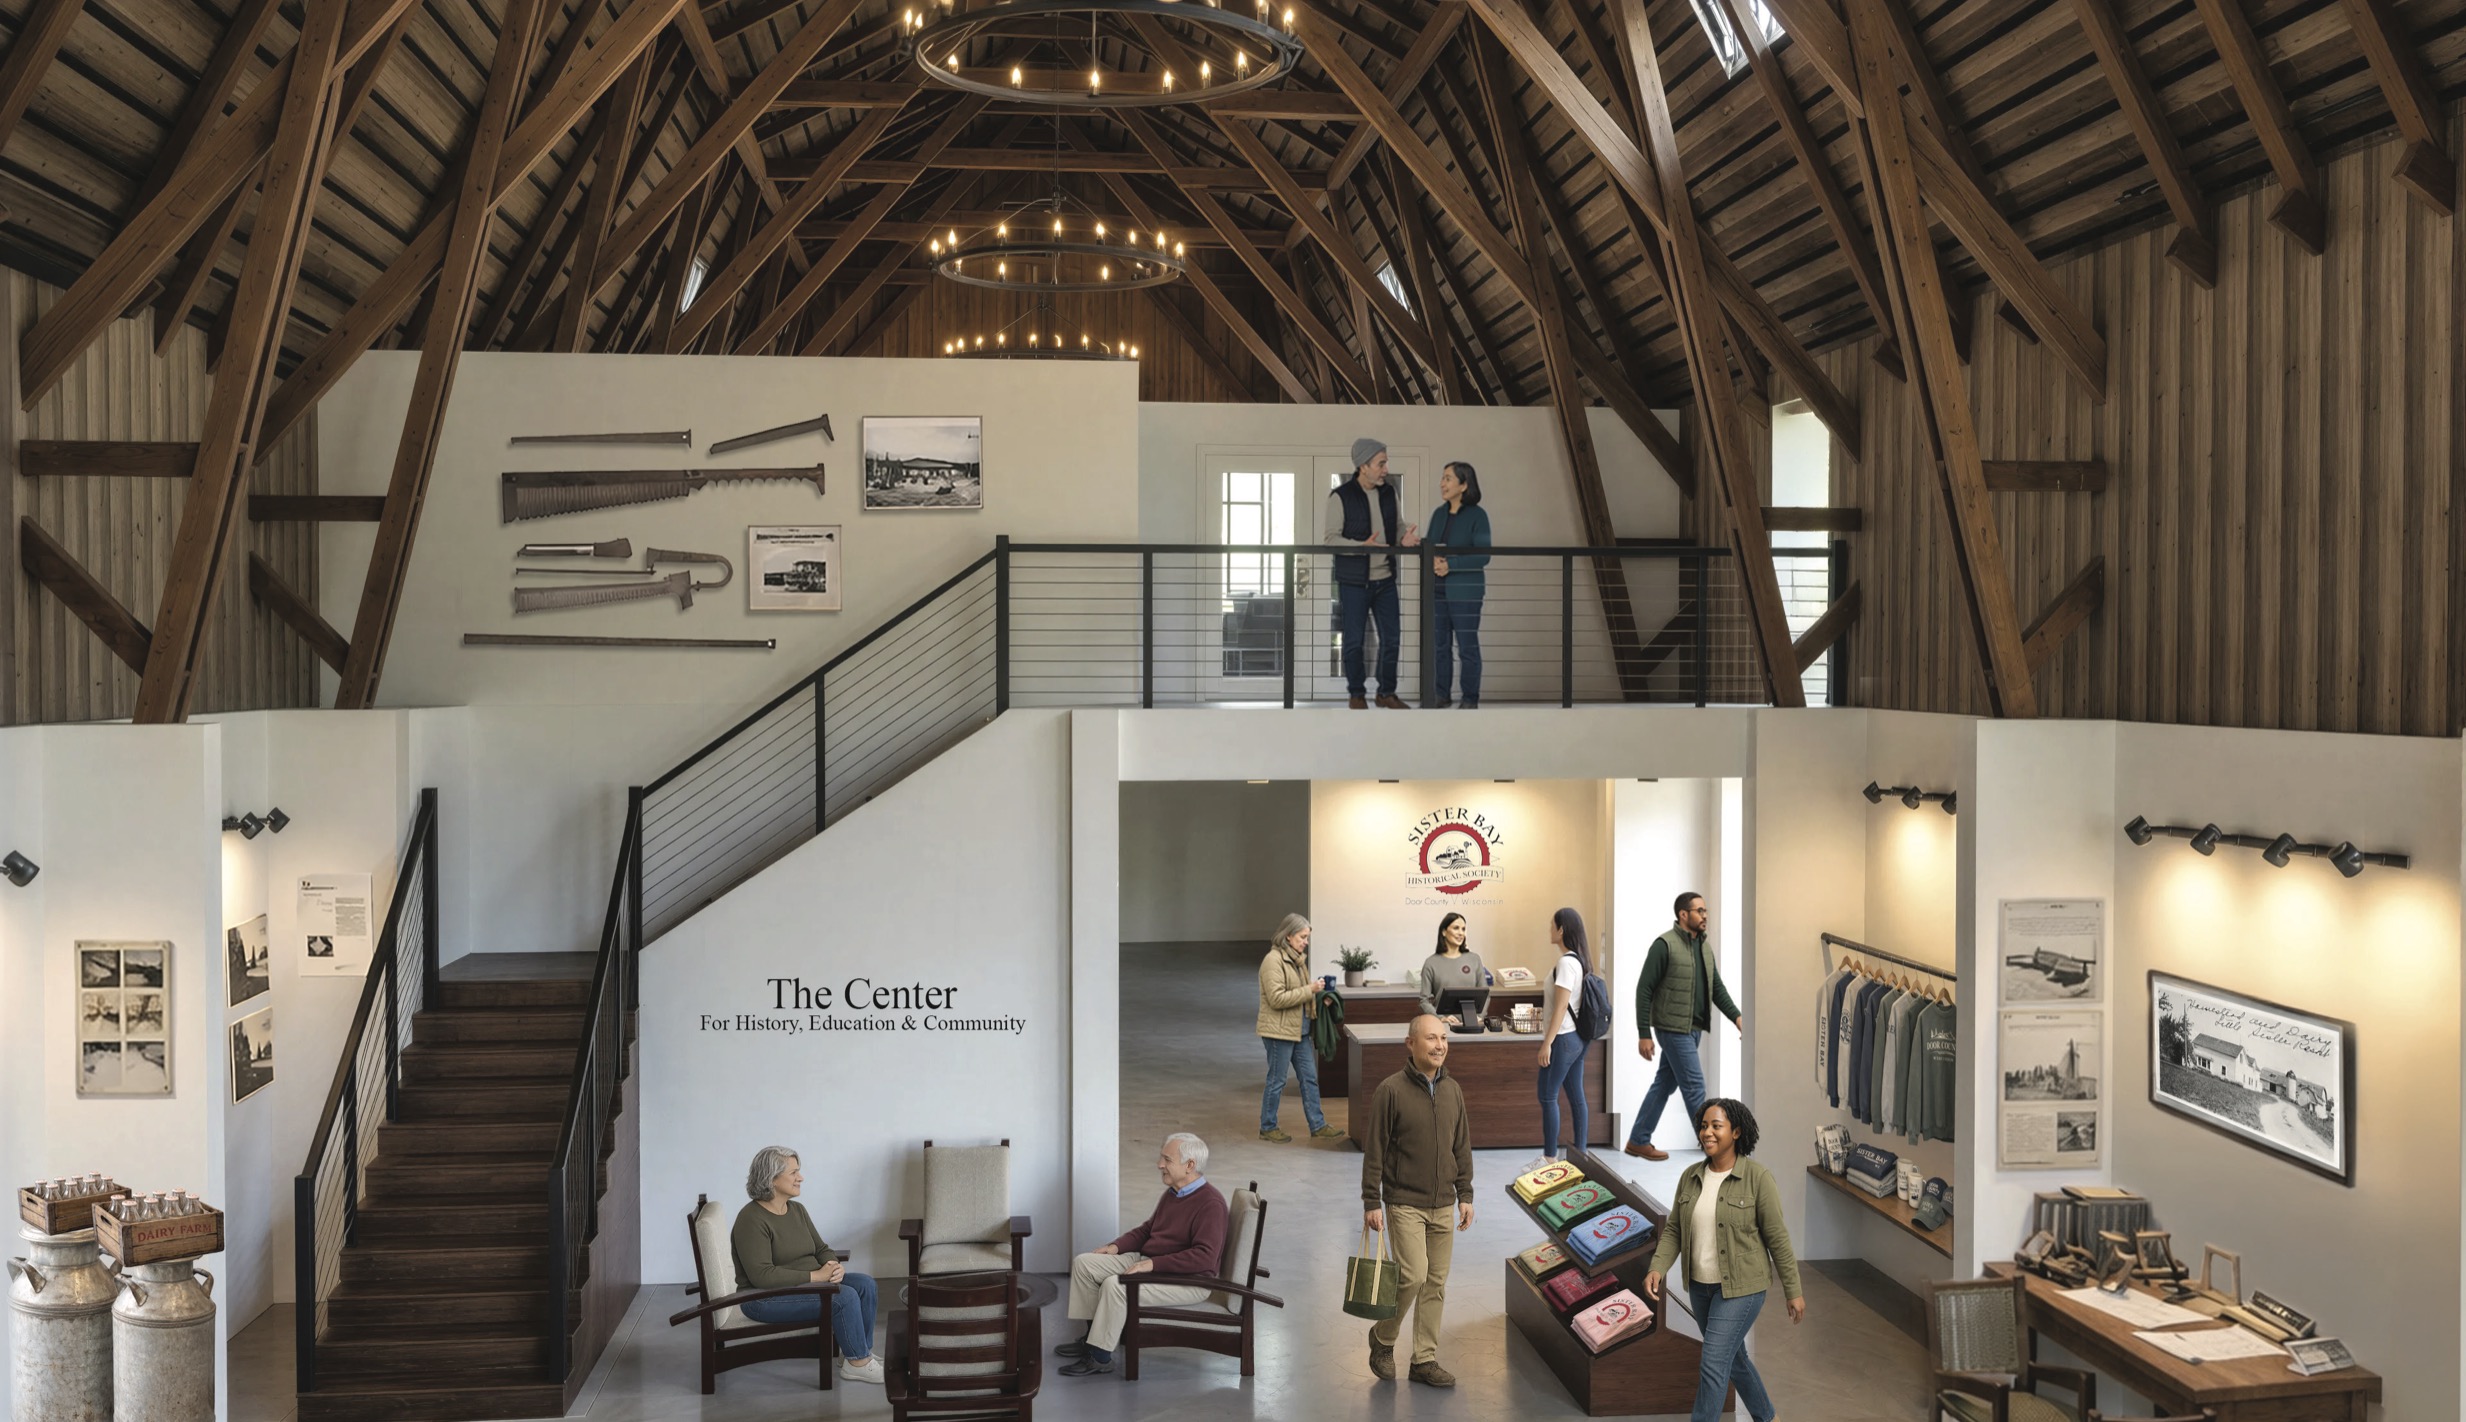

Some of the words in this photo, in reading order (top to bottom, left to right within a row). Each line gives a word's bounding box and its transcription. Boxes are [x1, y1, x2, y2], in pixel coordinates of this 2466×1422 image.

[1408, 807, 1469, 846] SISTER
[1474, 813, 1504, 846] BAY
[1408, 873, 1461, 884] HISTORICAL
[1462, 869, 1502, 878] SOCIETY
[1405, 897, 1422, 905] Door
[1424, 897, 1449, 906] County
[1461, 897, 1504, 906] Wisconsin
[766, 977, 833, 1010] The
[844, 976, 958, 1010] Center
[700, 1014, 730, 1031] For
[735, 1014, 804, 1035] History,
[808, 1014, 896, 1031] Education
[901, 1014, 918, 1031] &
[923, 1014, 1027, 1035] Community
[2248, 1017, 2282, 1030] and
[2285, 1026, 2332, 1050] Dairy
[1941, 1041, 1956, 1052] COUN
[1856, 1148, 1875, 1158] SISTER
[1875, 1154, 1888, 1164] BAY
[137, 1227, 175, 1242] DAIRY
[180, 1223, 212, 1235] FARM
